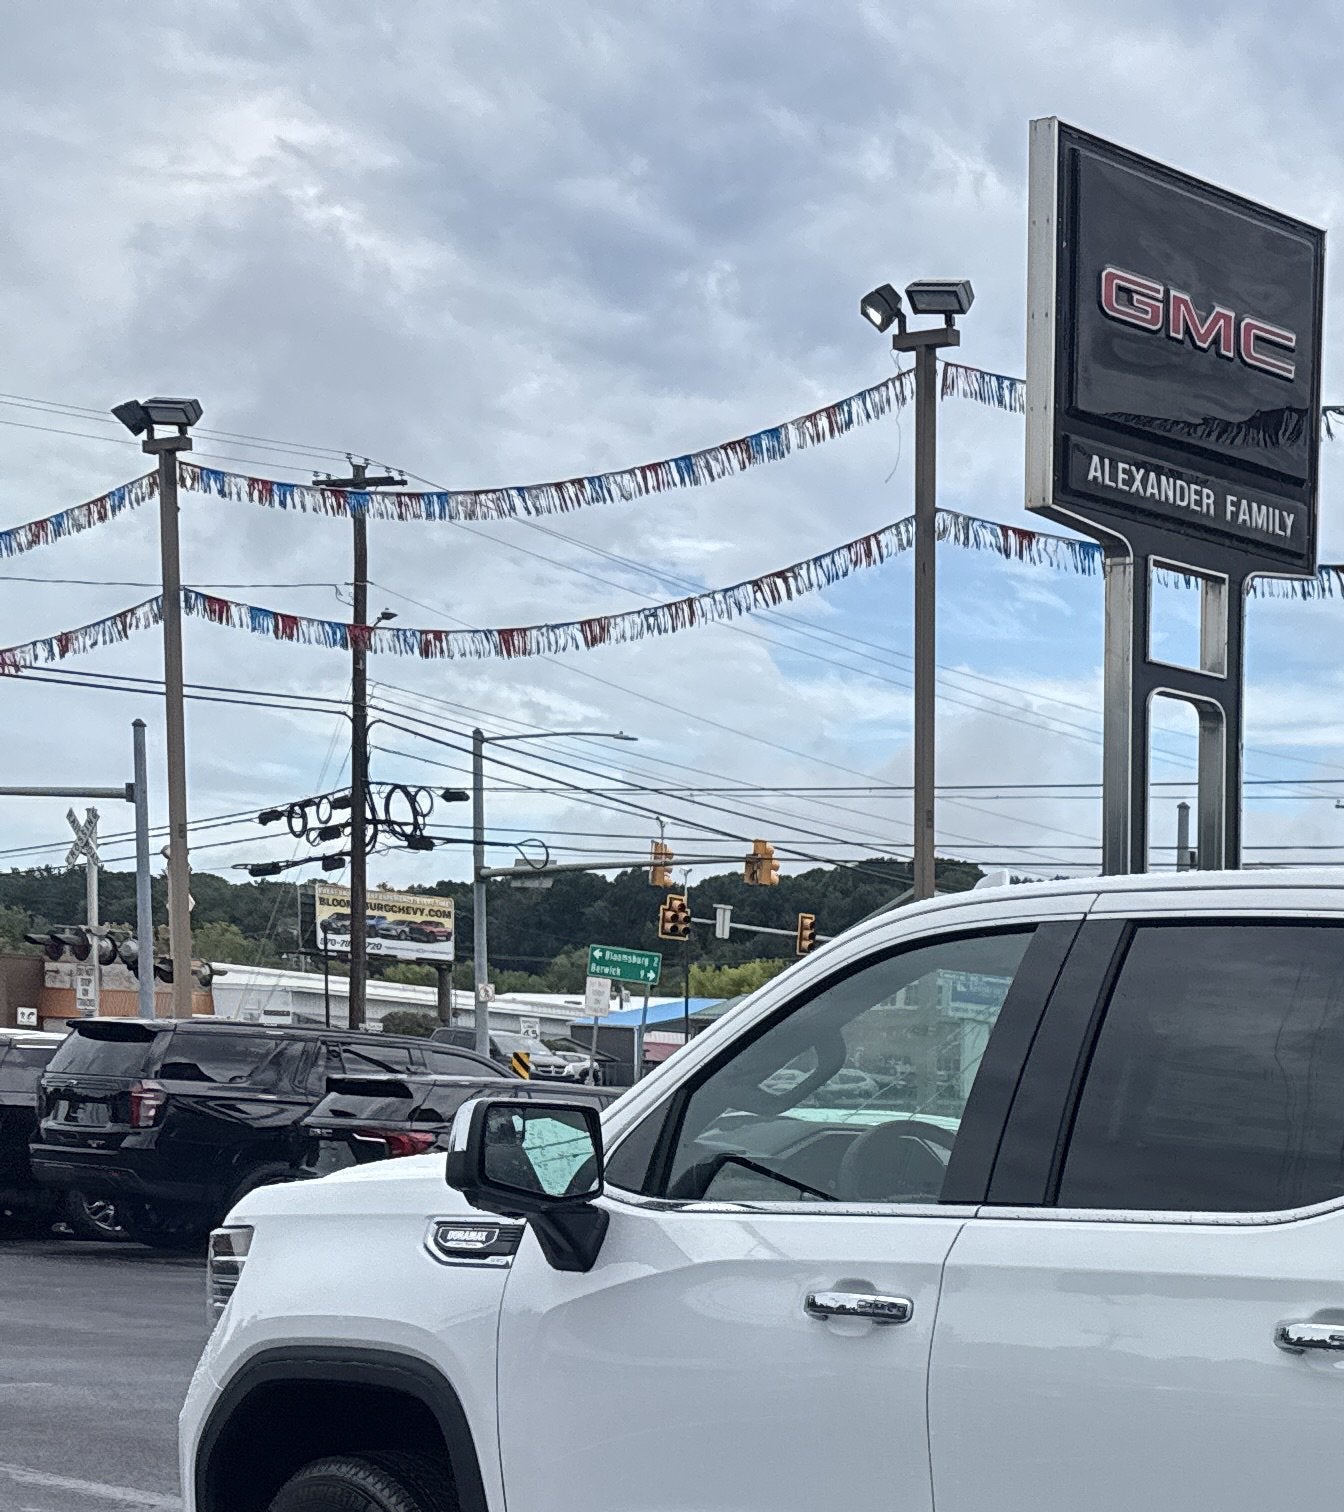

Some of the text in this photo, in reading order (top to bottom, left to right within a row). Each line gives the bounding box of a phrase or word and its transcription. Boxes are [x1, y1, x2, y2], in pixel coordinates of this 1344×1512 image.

[1101, 267, 1296, 379] GMC
[1087, 455, 1295, 538] ALEXANDER FAMILY
[319, 896, 452, 919] BLOOMBURGCHEVY.COM
[590, 963, 621, 976] Berwick
[604, 951, 659, 968] Bloomsburg 2
